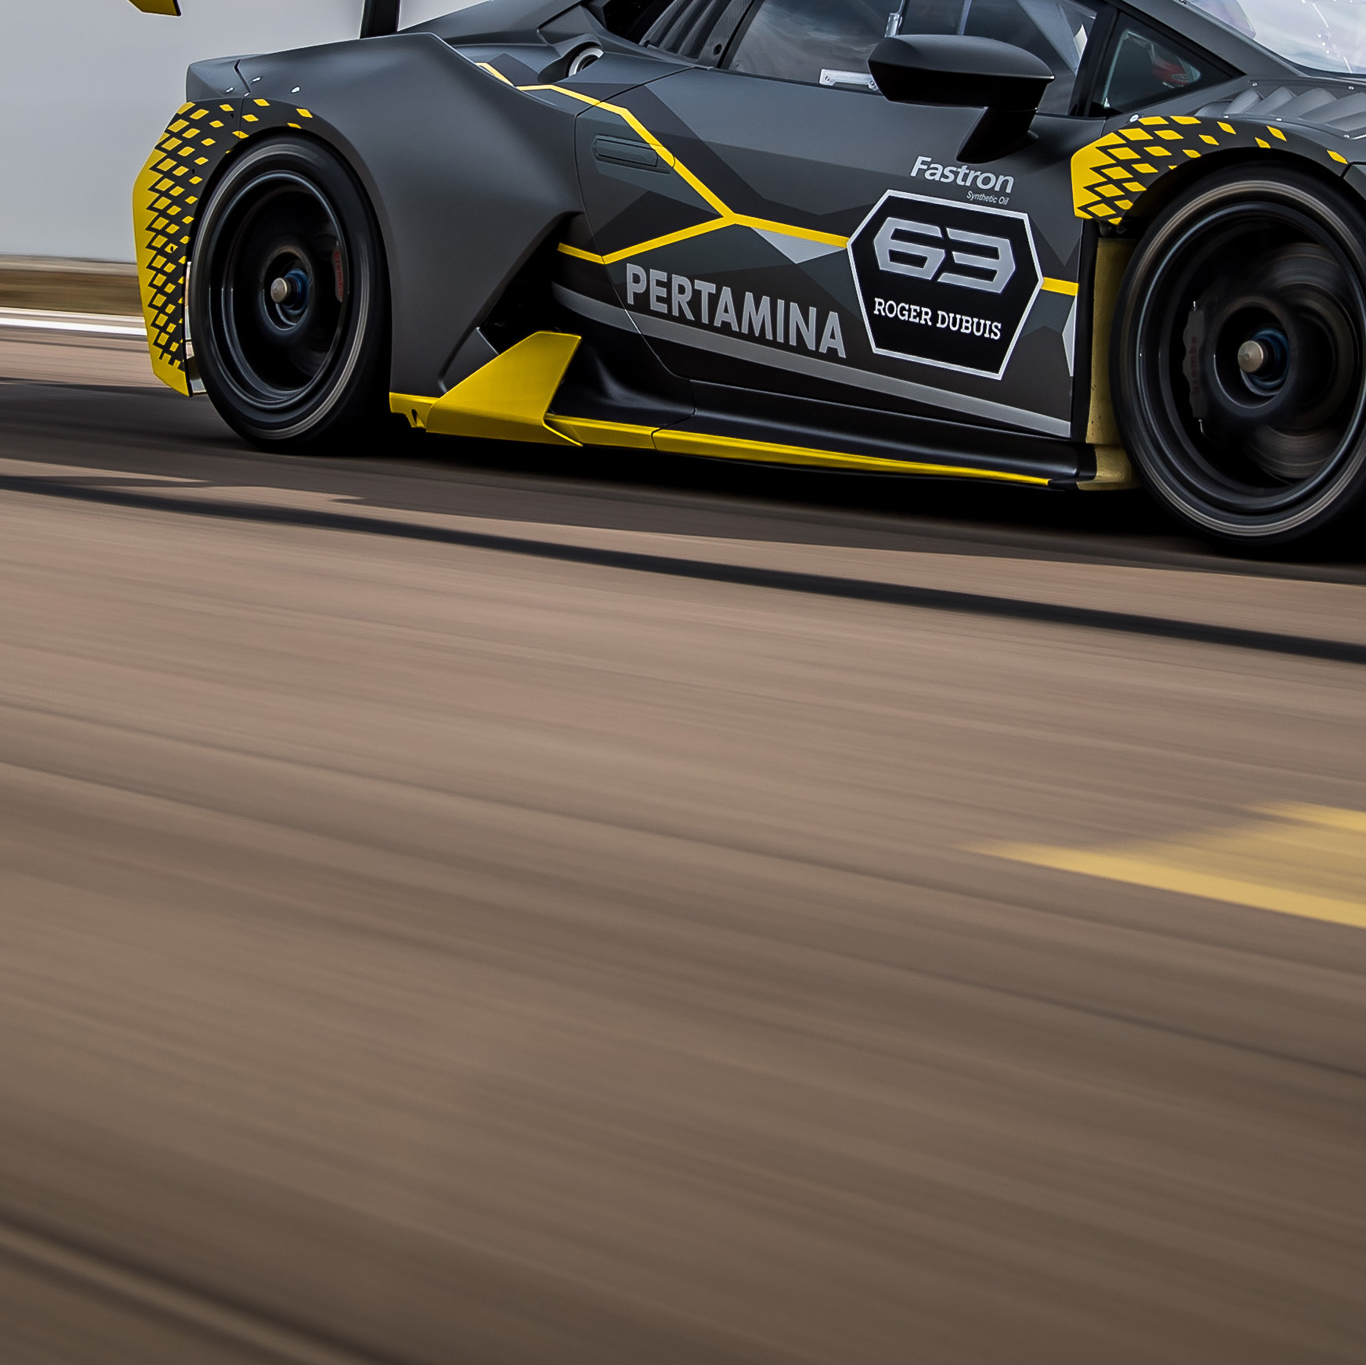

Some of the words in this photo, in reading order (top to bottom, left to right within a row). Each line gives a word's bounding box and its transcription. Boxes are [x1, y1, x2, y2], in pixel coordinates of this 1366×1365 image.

[910, 155, 1015, 194] Fastron
[966, 190, 998, 203] Synthetic
[998, 196, 1010, 205] Oil
[873, 217, 1016, 294] 63
[626, 263, 847, 359] PERTAMINA
[873, 297, 932, 326] ROGER
[936, 310, 1002, 340] DUBUIS
[1188, 336, 1200, 395] brembo
